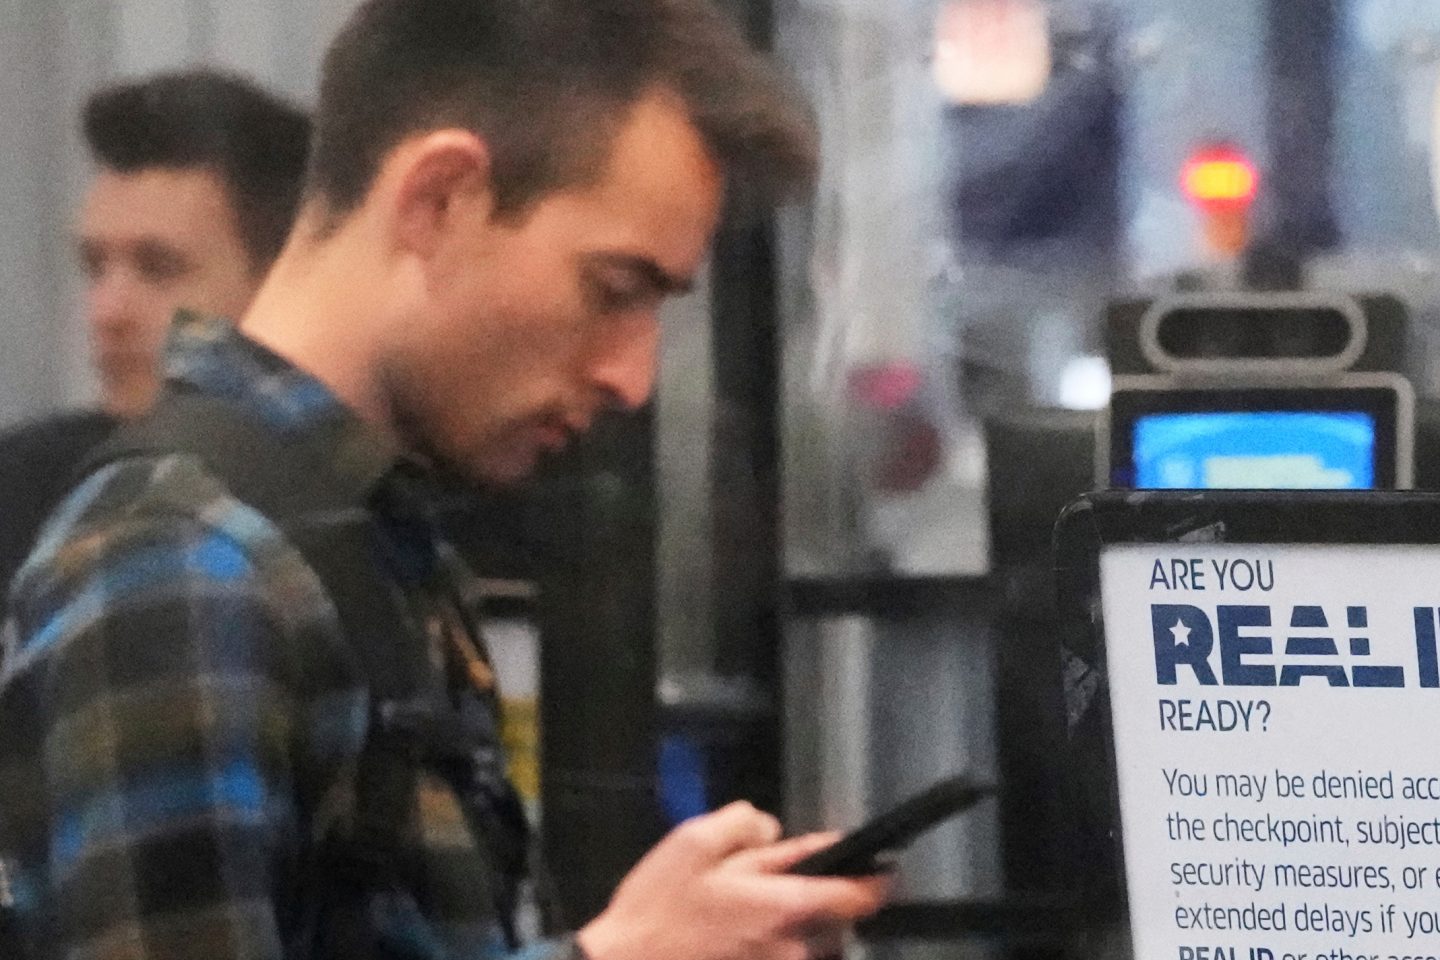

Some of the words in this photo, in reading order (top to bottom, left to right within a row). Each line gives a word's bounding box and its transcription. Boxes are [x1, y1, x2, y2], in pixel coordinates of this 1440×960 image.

[1150, 559, 1205, 590] ARE
[1212, 559, 1274, 591] YOU
[1151, 604, 1405, 688] REAL
[1159, 699, 1271, 732] READY?
[1162, 769, 1207, 797] You
[1216, 775, 1267, 802] may
[1275, 769, 1305, 798] be
[1312, 770, 1394, 799] denied
[1166, 812, 1205, 841] the
[1213, 812, 1349, 847] checkpoint,
[1171, 859, 1265, 892] security
[1274, 864, 1395, 892] measures,
[1403, 867, 1427, 889] or
[1175, 902, 1286, 931] extended
[1294, 902, 1373, 936] delays
[1381, 904, 1395, 933] if
